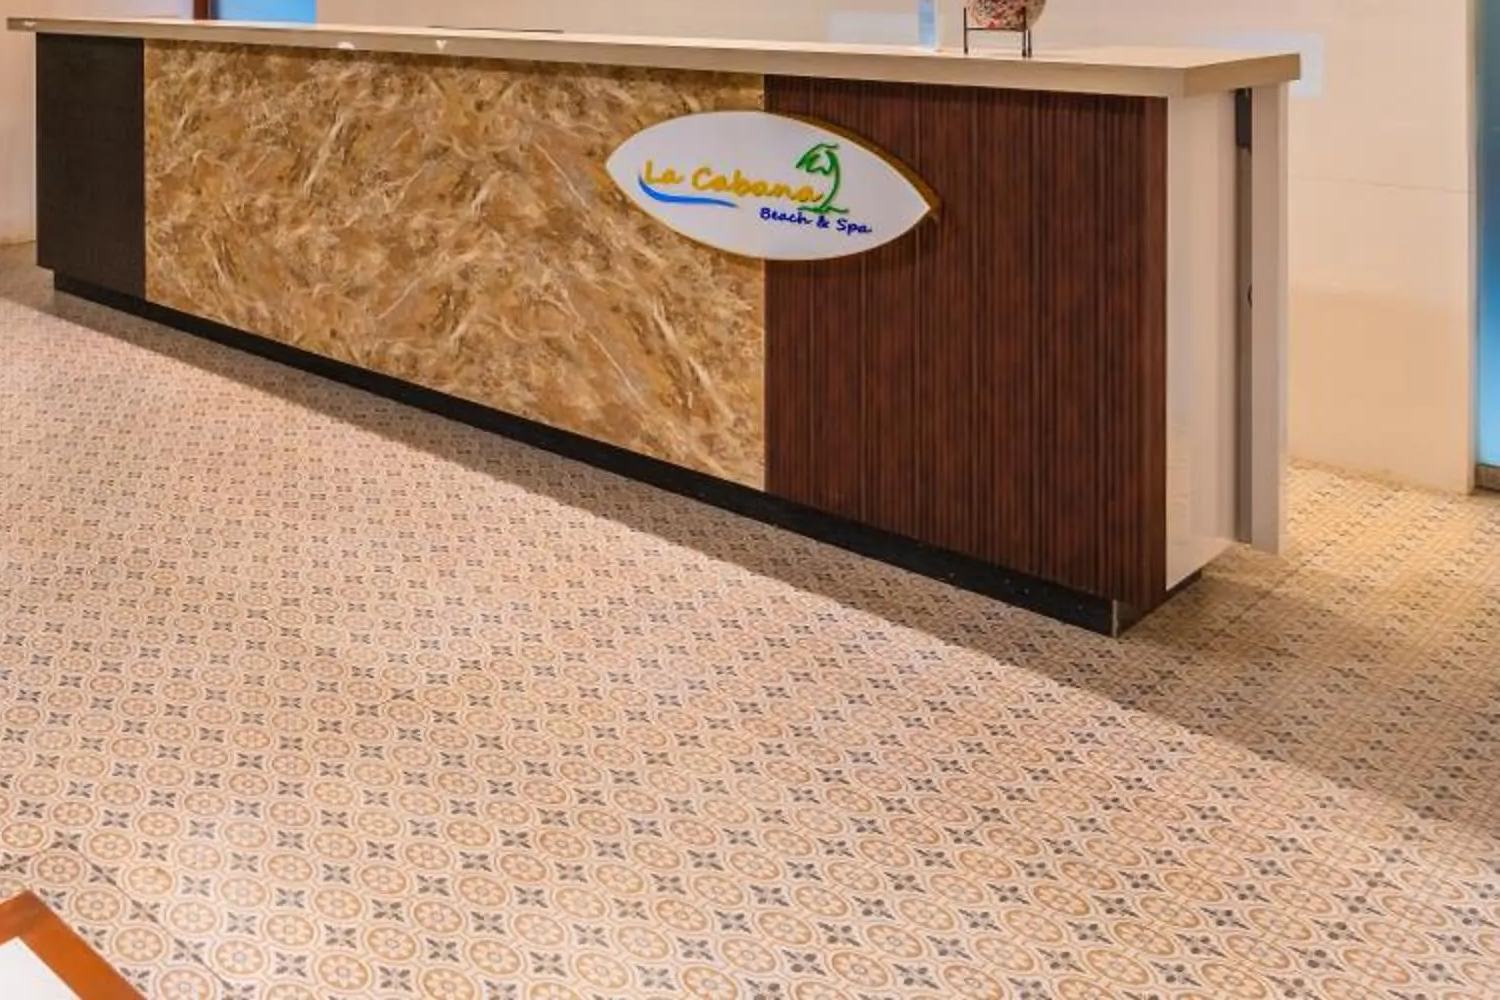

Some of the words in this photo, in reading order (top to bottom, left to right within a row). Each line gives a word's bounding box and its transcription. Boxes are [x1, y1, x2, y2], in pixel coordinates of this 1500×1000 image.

[644, 160, 684, 185] La
[690, 166, 824, 202] Cabana
[759, 207, 813, 225] Beach
[816, 215, 830, 229] &
[836, 217, 872, 236] Spa
